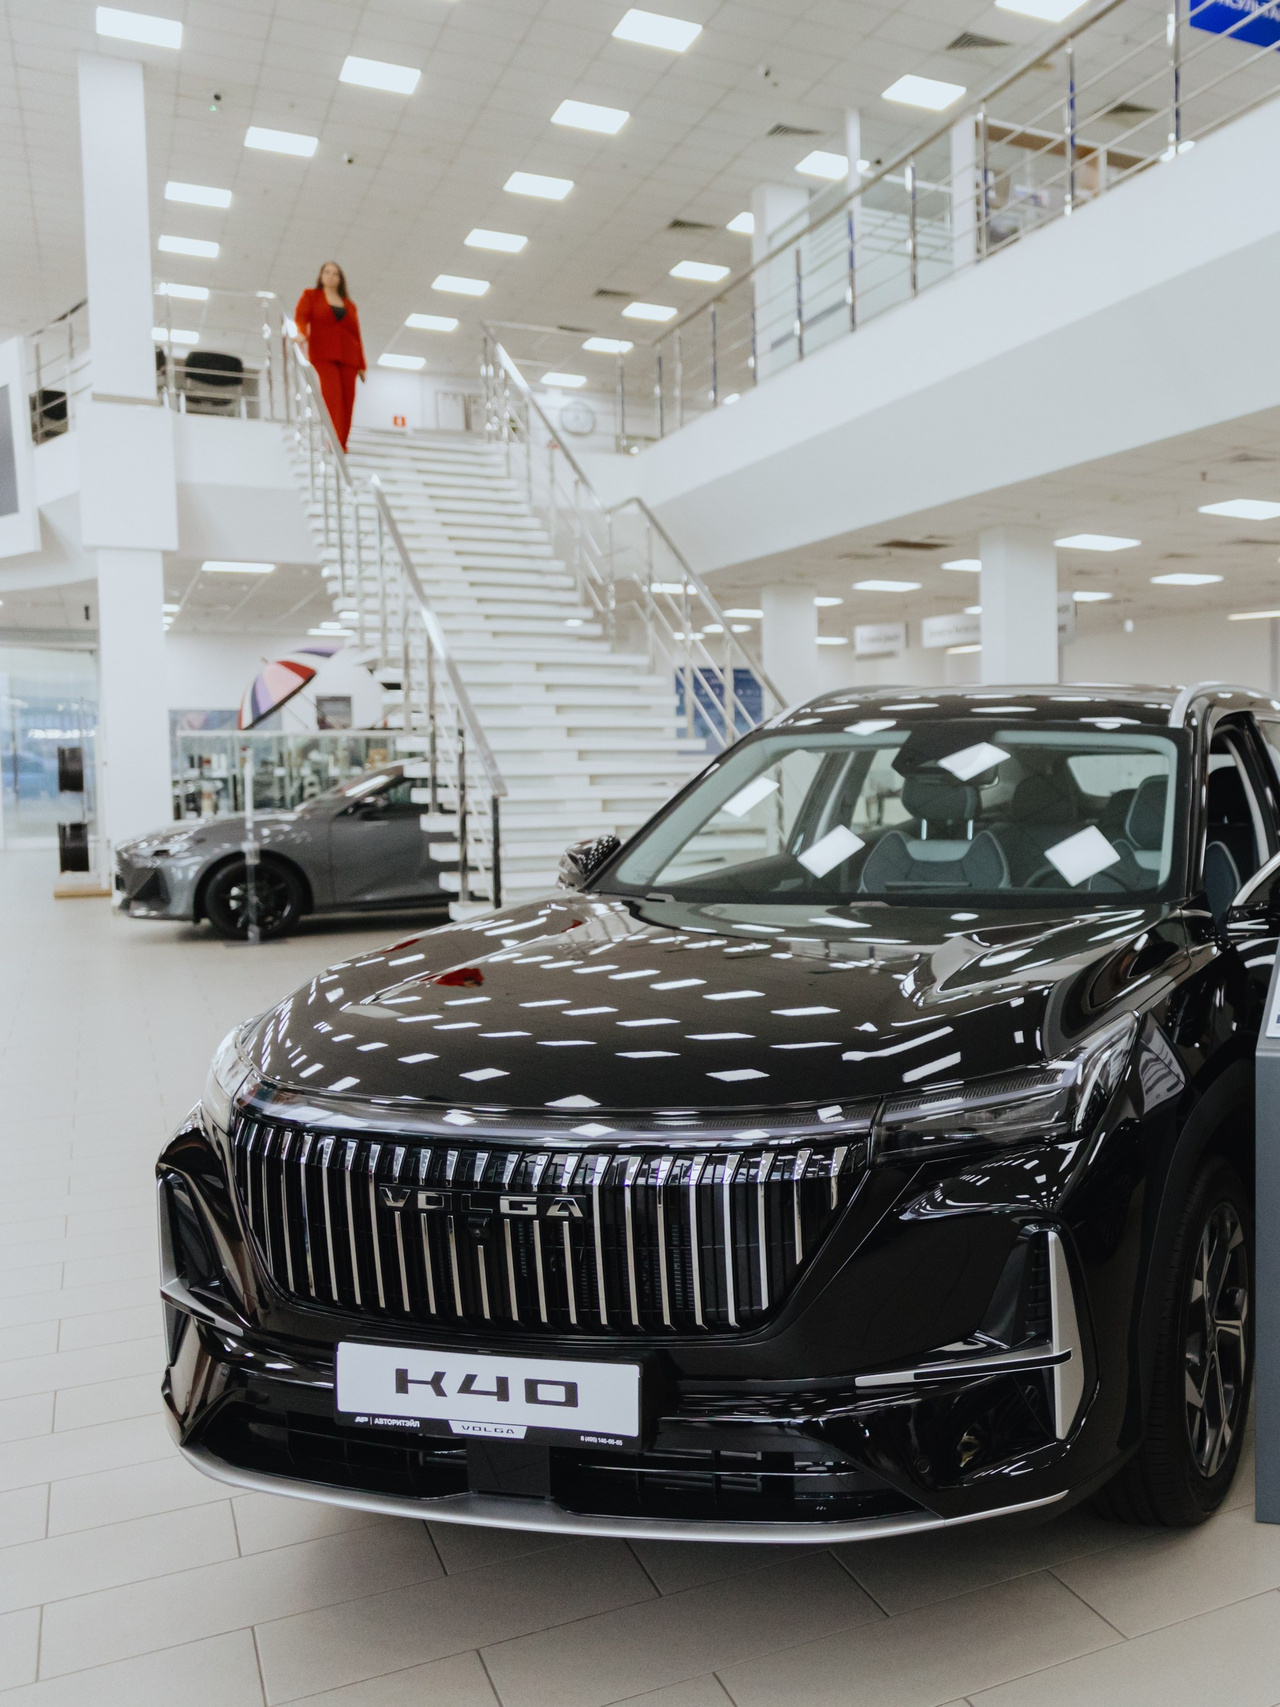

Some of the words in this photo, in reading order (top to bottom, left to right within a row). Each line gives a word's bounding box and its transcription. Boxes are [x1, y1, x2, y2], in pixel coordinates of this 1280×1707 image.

[379, 1186, 583, 1217] VOLGA
[395, 1368, 579, 1408] K40
[374, 1417, 420, 1428] АВТОРИТЭЙЛ
[461, 1425, 515, 1434] VOLGA
